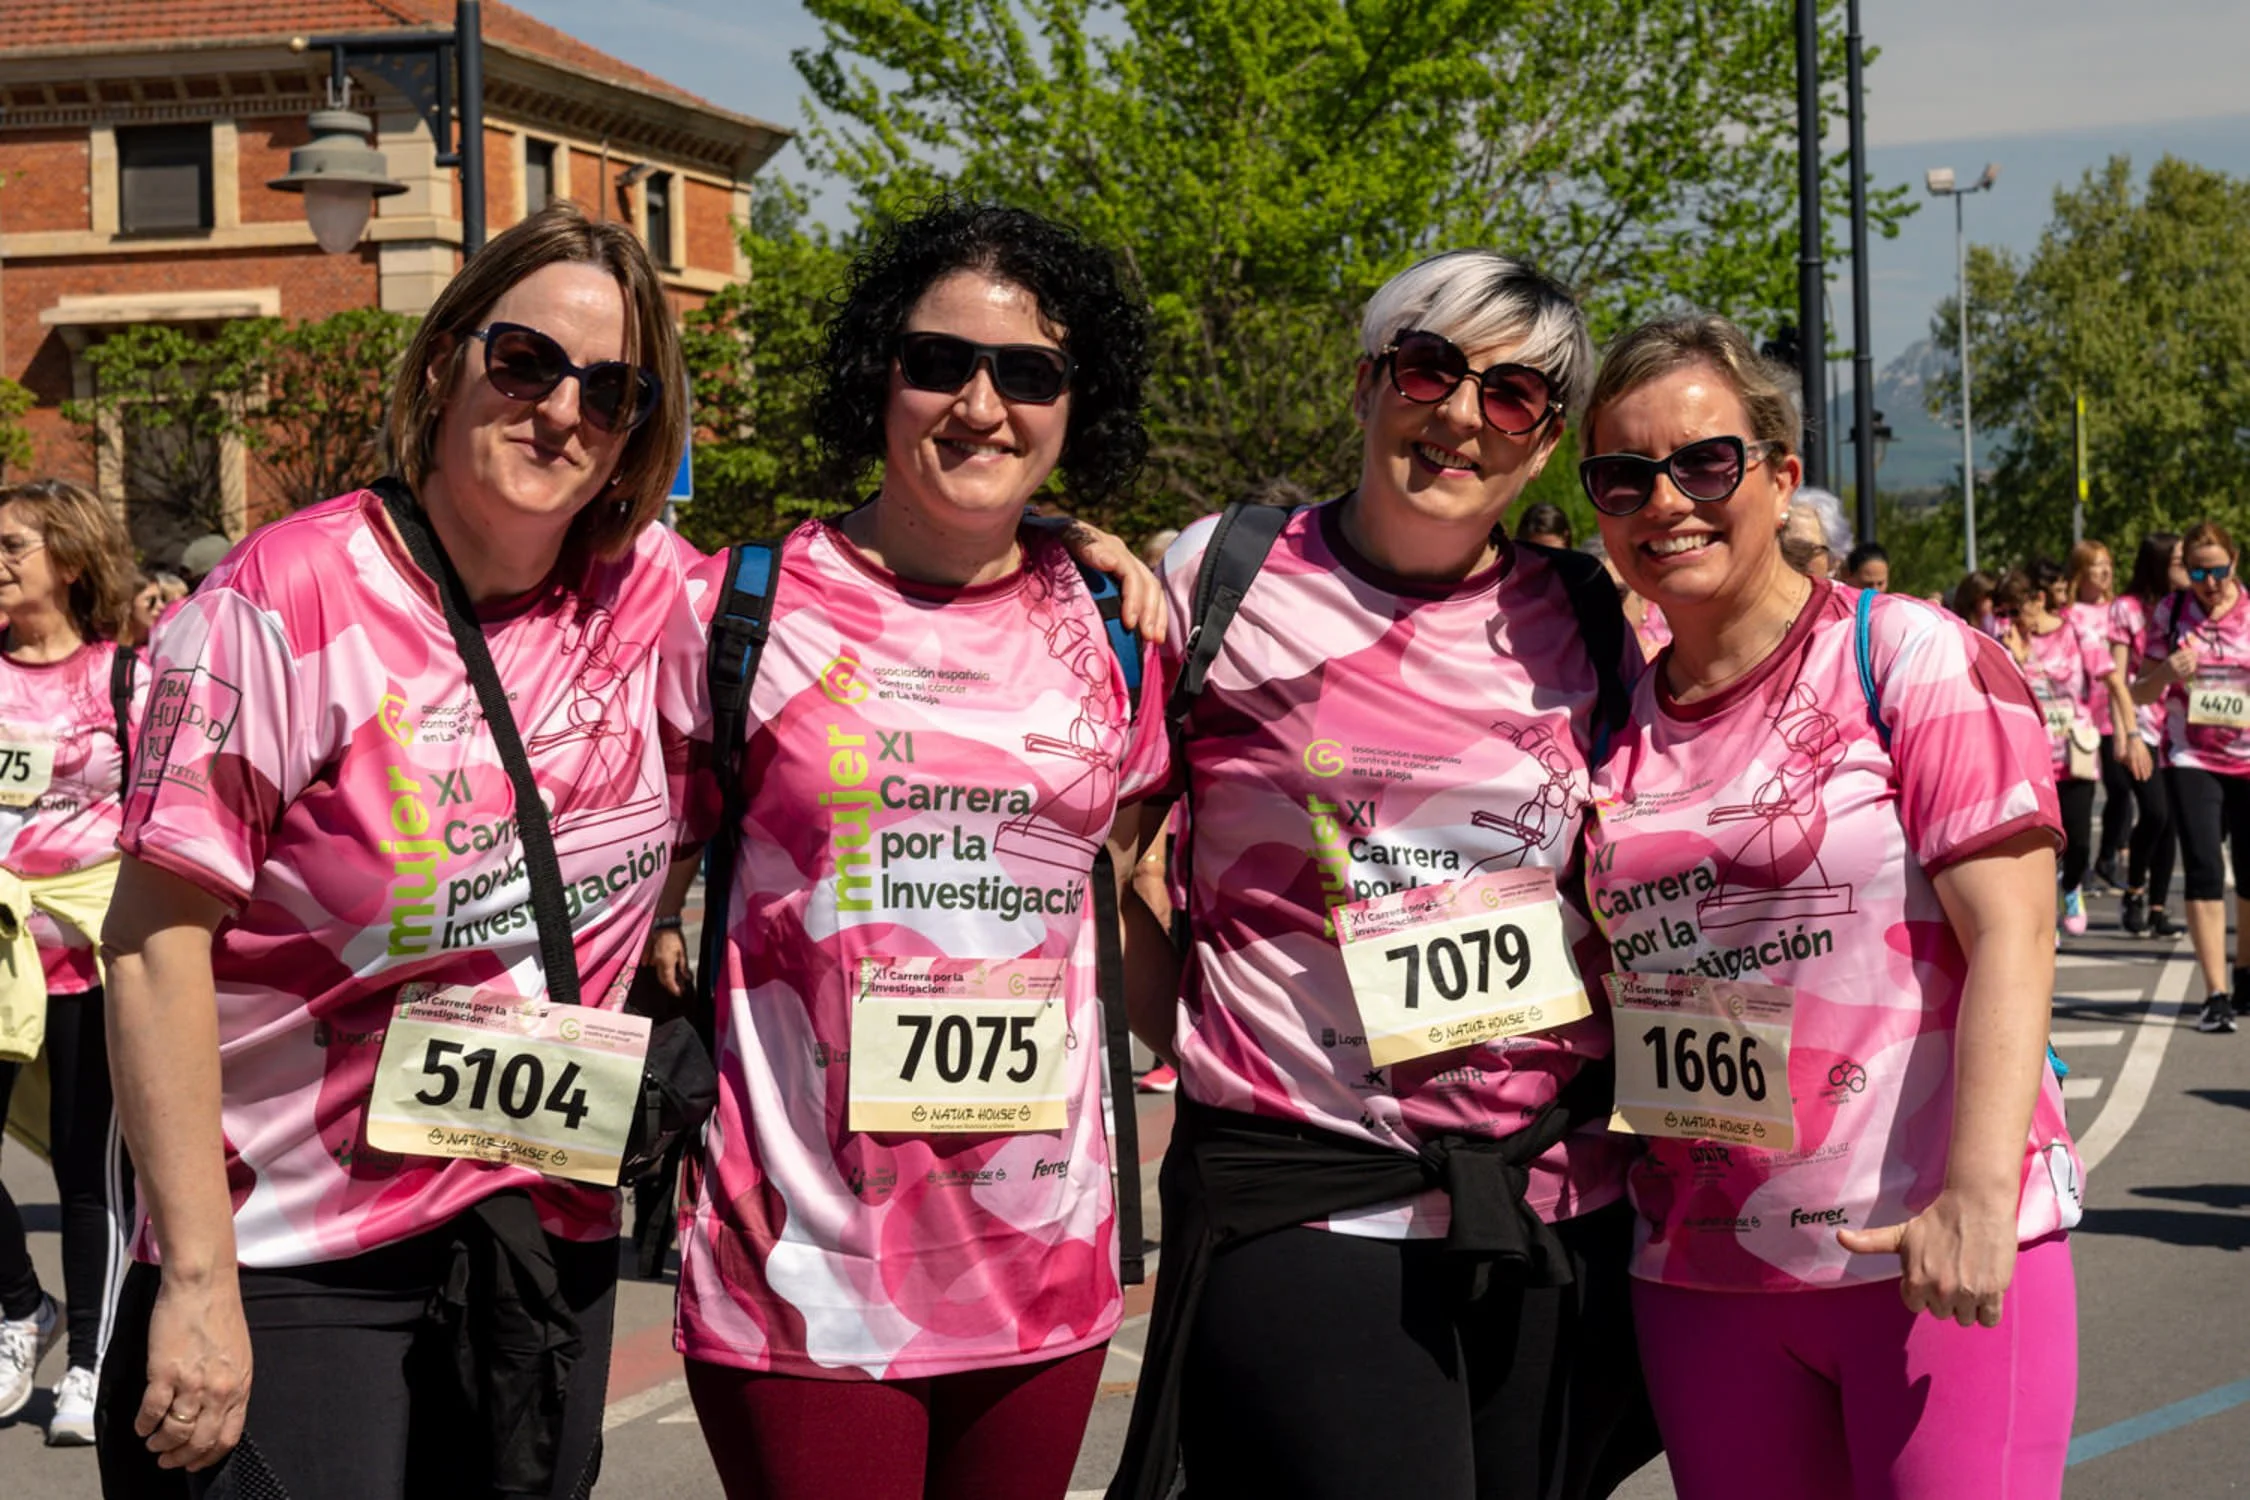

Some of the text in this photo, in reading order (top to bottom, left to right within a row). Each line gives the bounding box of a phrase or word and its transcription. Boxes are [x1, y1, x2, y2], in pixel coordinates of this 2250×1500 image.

[873, 666, 990, 682] asociación española
[879, 690, 894, 699] en
[2200, 695, 2243, 716] 4470
[875, 730, 915, 764] XI
[1352, 746, 1410, 758] asociación
[1352, 767, 1413, 782] en La Rioja
[1403, 760, 1441, 771] cáncer
[429, 767, 473, 807] XI
[880, 775, 1030, 815] Carrera
[819, 724, 883, 912] mujer
[1347, 799, 1376, 828] XI
[380, 765, 450, 957] mujer
[881, 825, 986, 868] por la
[1348, 836, 1460, 871] Carrera
[1592, 841, 1617, 878] XI
[441, 839, 667, 949] Invesgación
[446, 866, 507, 917] por
[1595, 865, 1716, 919] Carrera
[1351, 911, 1366, 926] XI
[1612, 916, 1698, 972] por la
[889, 971, 931, 981] Carrera
[934, 973, 951, 983] por
[953, 972, 964, 982] la
[1385, 923, 1531, 1009] 7079
[432, 996, 472, 1010] Carrera
[474, 1003, 493, 1014] por
[1635, 985, 1669, 995] Carrera
[1446, 1019, 1486, 1039] NATUR
[1488, 1011, 1526, 1030] HOUSE
[897, 1014, 1038, 1083] 7075
[1642, 1026, 1767, 1102] 1666
[415, 1038, 588, 1130] 5104
[930, 1107, 1017, 1120] NATUR HOUSE
[1680, 1115, 1718, 1129] NATUR
[1791, 1208, 1846, 1229] Ferrer
